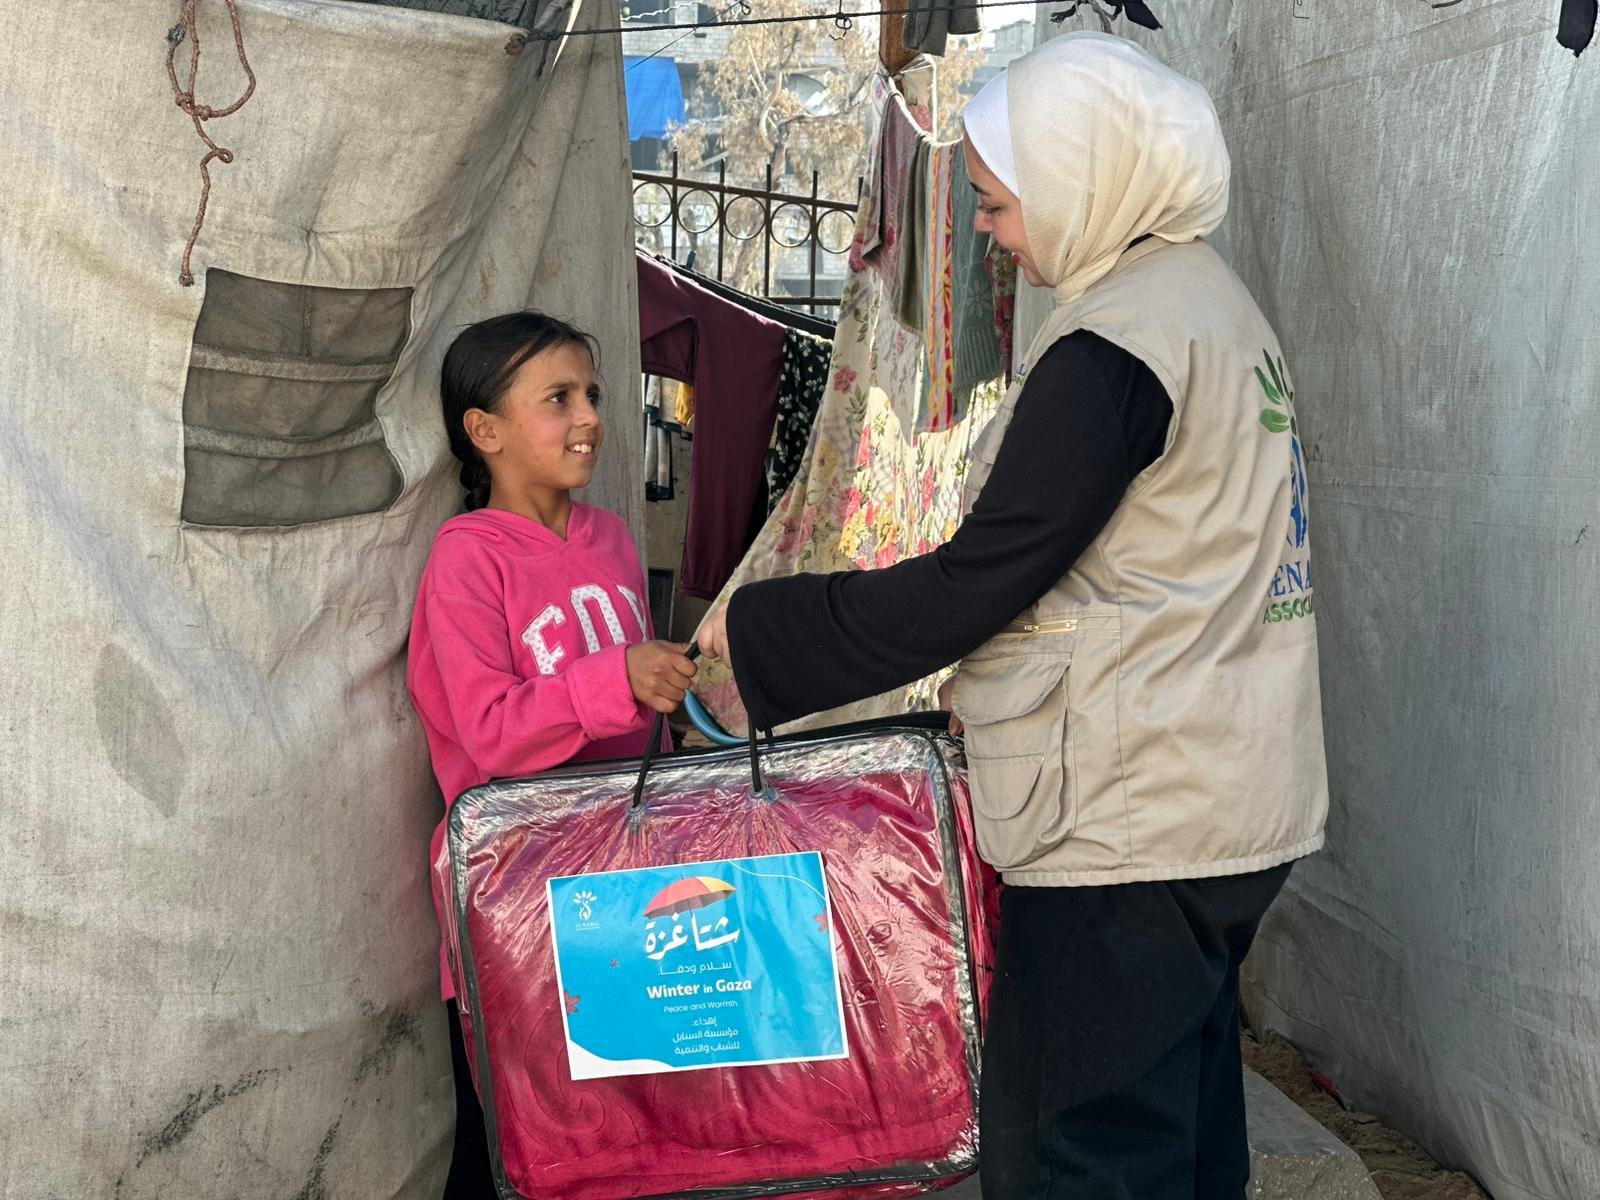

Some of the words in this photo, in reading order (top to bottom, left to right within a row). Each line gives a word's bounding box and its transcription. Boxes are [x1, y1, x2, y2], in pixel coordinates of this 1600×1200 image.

[644, 912, 689, 960] غزة
[646, 984, 700, 999] Winter
[703, 983, 713, 994] in
[715, 979, 752, 992] Gaza
[664, 1005, 688, 1013] Peace
[690, 1002, 706, 1010] and
[707, 1000, 738, 1009] Warmth
